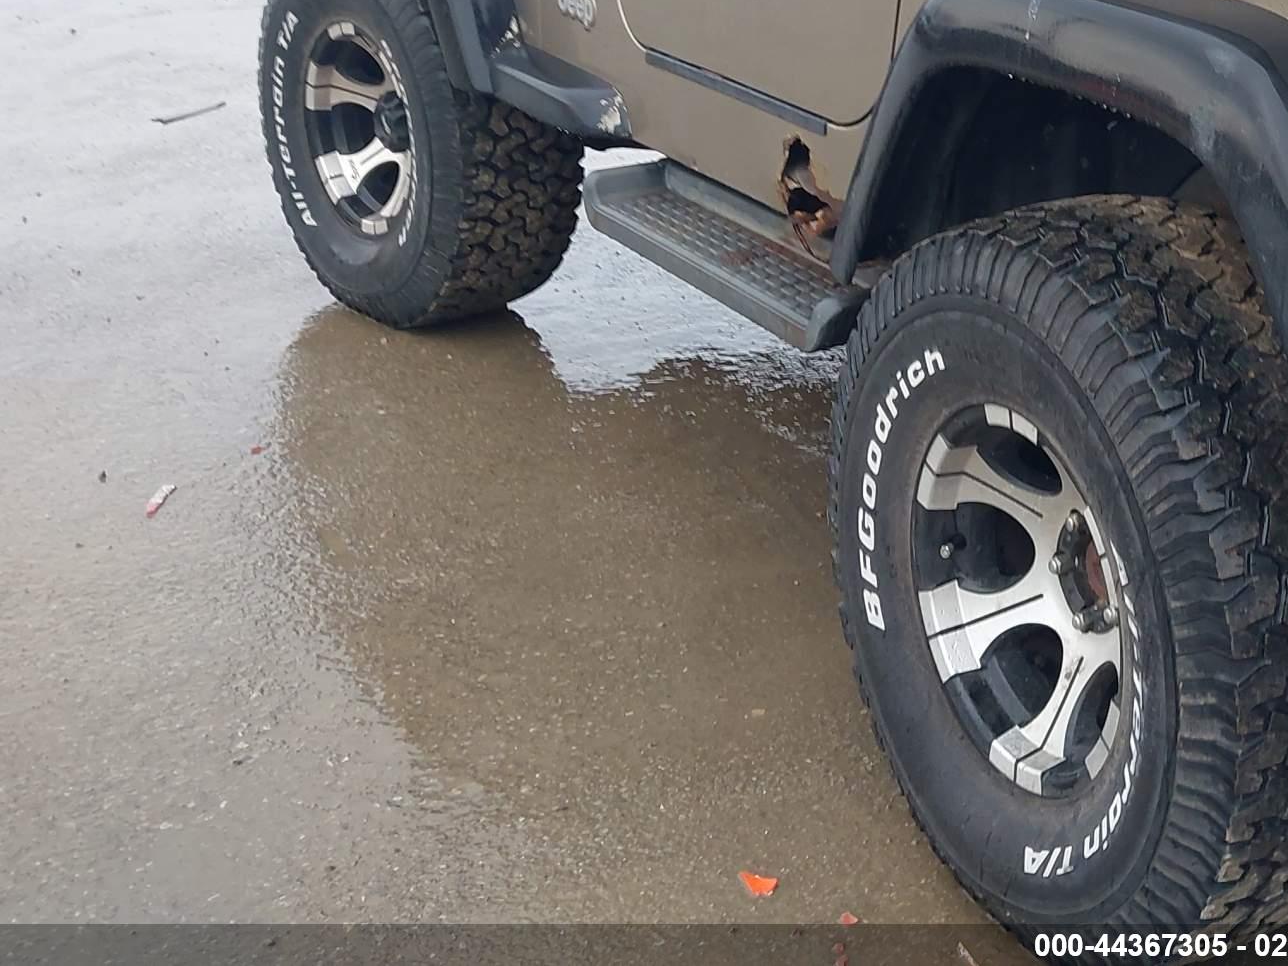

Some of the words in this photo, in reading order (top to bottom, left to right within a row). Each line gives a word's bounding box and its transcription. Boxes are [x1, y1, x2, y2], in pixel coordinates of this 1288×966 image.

[276, 10, 299, 50] T/A
[857, 347, 945, 631] BFGoodrich
[1024, 845, 1074, 878] T/A
